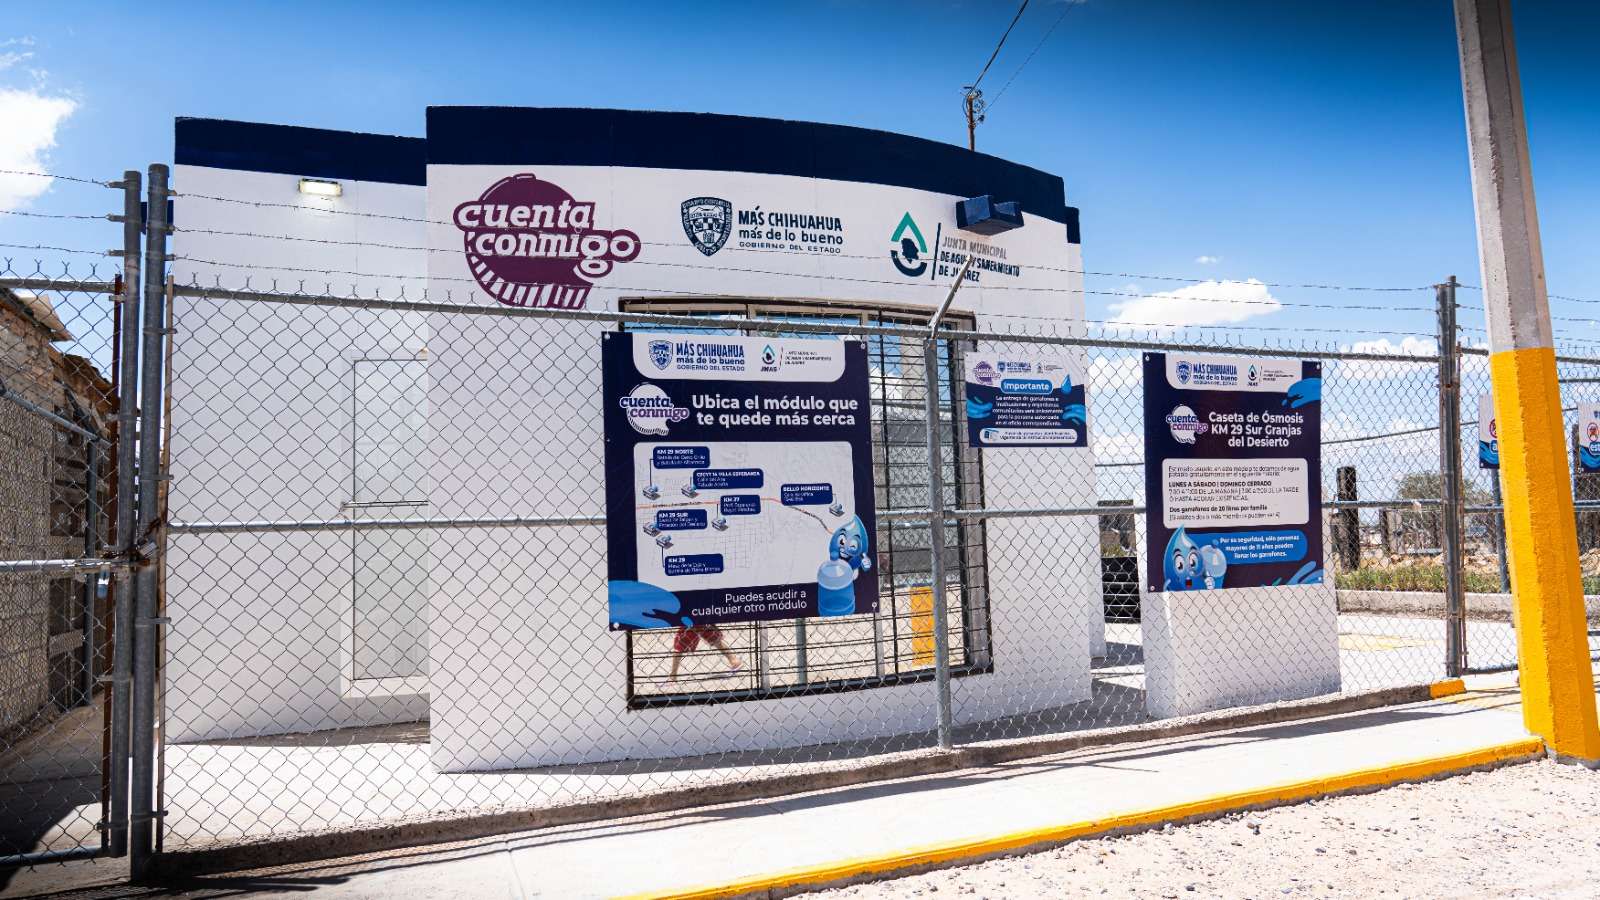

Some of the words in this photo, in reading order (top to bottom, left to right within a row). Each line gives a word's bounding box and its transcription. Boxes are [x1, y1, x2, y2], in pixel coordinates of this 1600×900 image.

[457, 200, 594, 228] cuenta
[738, 205, 764, 226] MÁS
[768, 212, 843, 231] CHIHUAHUA
[739, 227, 762, 239] más
[766, 229, 782, 240] de
[785, 229, 796, 242] lo
[802, 230, 843, 244] bueno
[475, 233, 636, 275] conmigo
[740, 241, 785, 249] GOBIERNO
[808, 245, 841, 254] ESTADO
[942, 236, 967, 250] JUNTA
[969, 241, 1008, 260] MUNICIPAL
[938, 265, 948, 276] DE
[940, 251, 950, 262] DE
[950, 253, 969, 266] AGU
[977, 258, 1020, 278] SANEAMIENTO
[676, 340, 695, 356] MÁS
[697, 343, 745, 358] CHIHUAHUA
[676, 356, 694, 364] más
[709, 357, 717, 365] lo
[719, 357, 745, 365] bueno
[1206, 364, 1238, 375] CHIHUAHUA
[619, 395, 673, 408] cuenta
[692, 394, 740, 409] Ubica
[744, 394, 760, 410] el
[763, 395, 826, 410] módulo
[828, 399, 859, 413] que
[630, 407, 690, 422] conmigo
[696, 412, 714, 425] te
[718, 411, 772, 429] quede
[776, 411, 809, 425] más
[813, 414, 856, 425] cerca
[1166, 414, 1198, 423] cuenta
[1208, 412, 1244, 422] Caseta
[1246, 412, 1259, 422] de
[1262, 410, 1304, 423] Ósmosis
[1172, 423, 1208, 434] conmigo
[1211, 424, 1228, 434] KM
[1230, 424, 1243, 434] 29
[1246, 424, 1262, 434] Sur
[1264, 424, 1302, 438] Granjas
[1228, 436, 1244, 447] del
[1246, 436, 1290, 447] Desierto
[726, 592, 764, 604] Puedes
[766, 590, 798, 600] acudir
[800, 590, 806, 598] a
[691, 604, 741, 616] cualquier
[744, 603, 766, 612] otro
[768, 600, 808, 612] módulo
